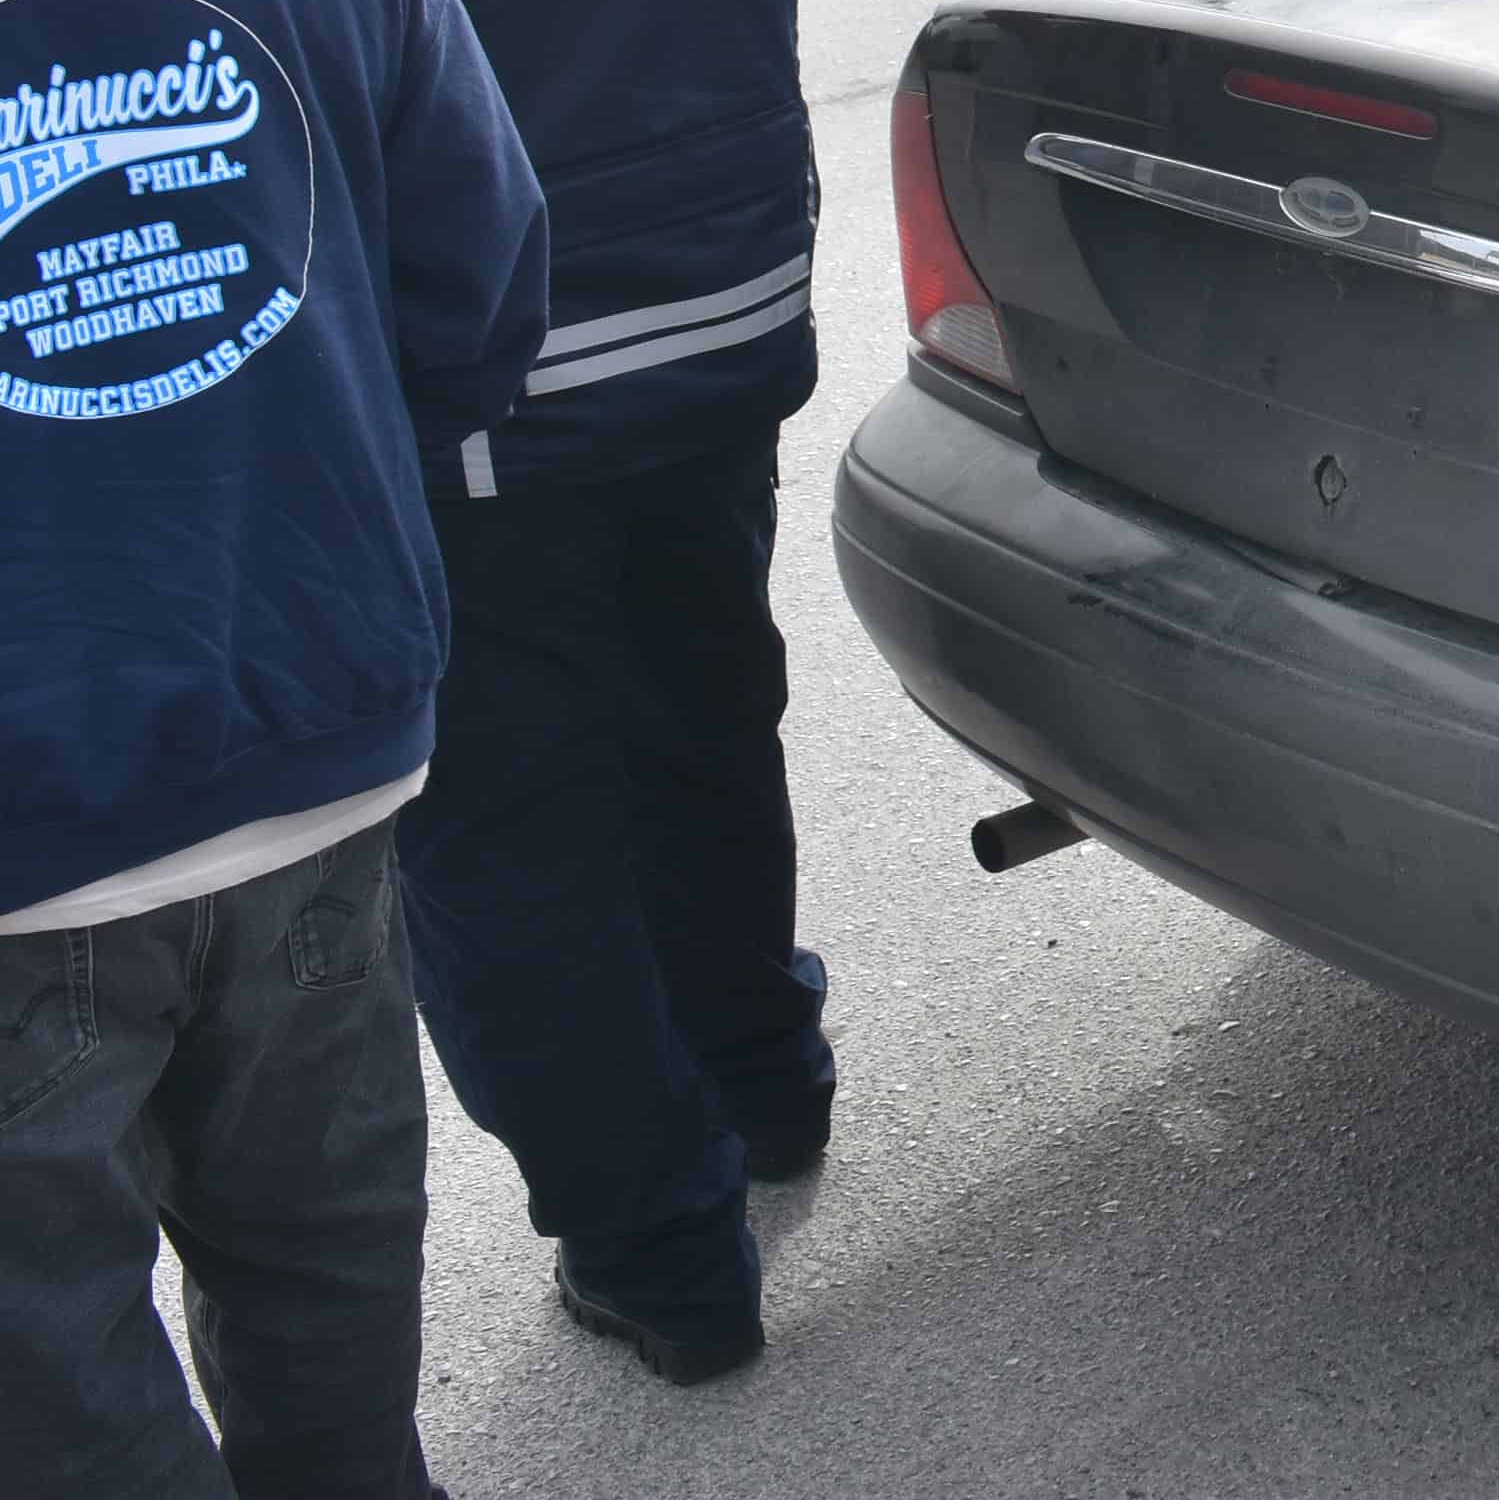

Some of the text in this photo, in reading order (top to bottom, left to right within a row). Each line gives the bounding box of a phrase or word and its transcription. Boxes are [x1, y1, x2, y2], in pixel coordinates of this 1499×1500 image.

[0, 139, 101, 222] DELI
[0, 243, 249, 333] PORT RICHMOND
[36, 221, 181, 282] MAYFAIR
[25, 283, 225, 358] WOODHAVEN
